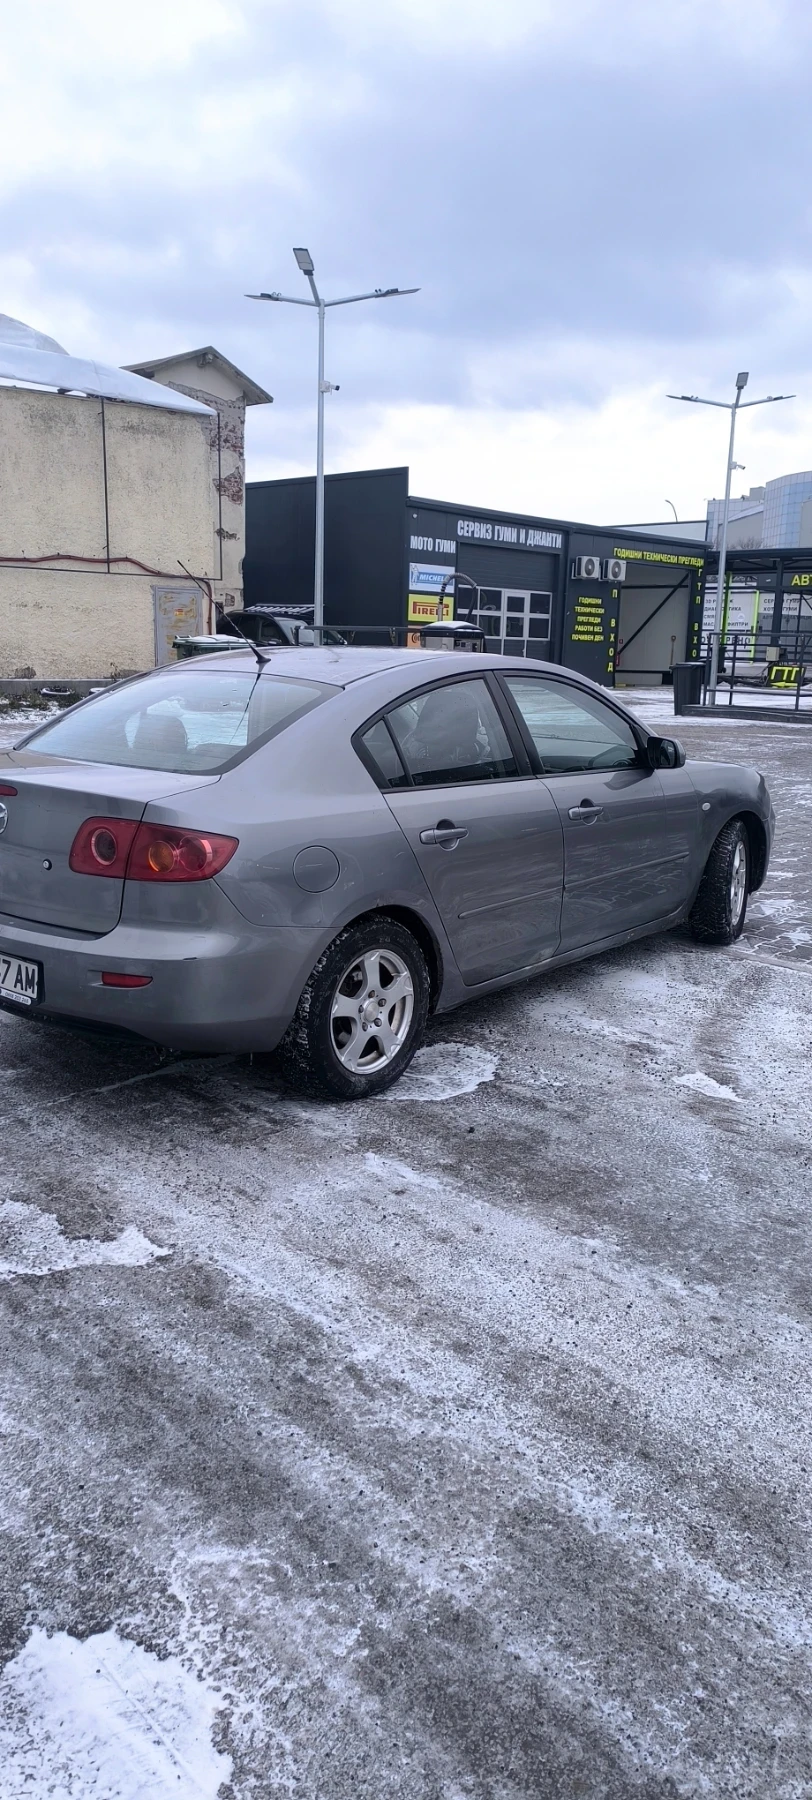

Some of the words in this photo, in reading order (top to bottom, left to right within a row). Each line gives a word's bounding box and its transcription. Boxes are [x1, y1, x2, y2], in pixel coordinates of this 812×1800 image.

[457, 520, 493, 539] СЕРВИЗ
[494, 525, 518, 544] ГУМИ
[519, 529, 526, 544] И
[526, 530, 562, 548] ДЖАНТИ
[410, 535, 434, 551] МОТО
[435, 539, 456, 554] ГУМИ
[613, 547, 643, 559] ГОДИШНИ
[643, 551, 678, 564] ТЕХНИЧЕСКИ
[678, 556, 704, 568] ПРЕГЛЕДИ
[419, 573, 446, 582] MICHEL
[574, 606, 605, 614] ТЕХНИЧЕСКИ
[578, 596, 602, 605] ГОДИШНИ
[571, 633, 594, 641] ПОЧИВЕН
[691, 622, 699, 657] ВХО
[13, 963, 36, 995] AM
